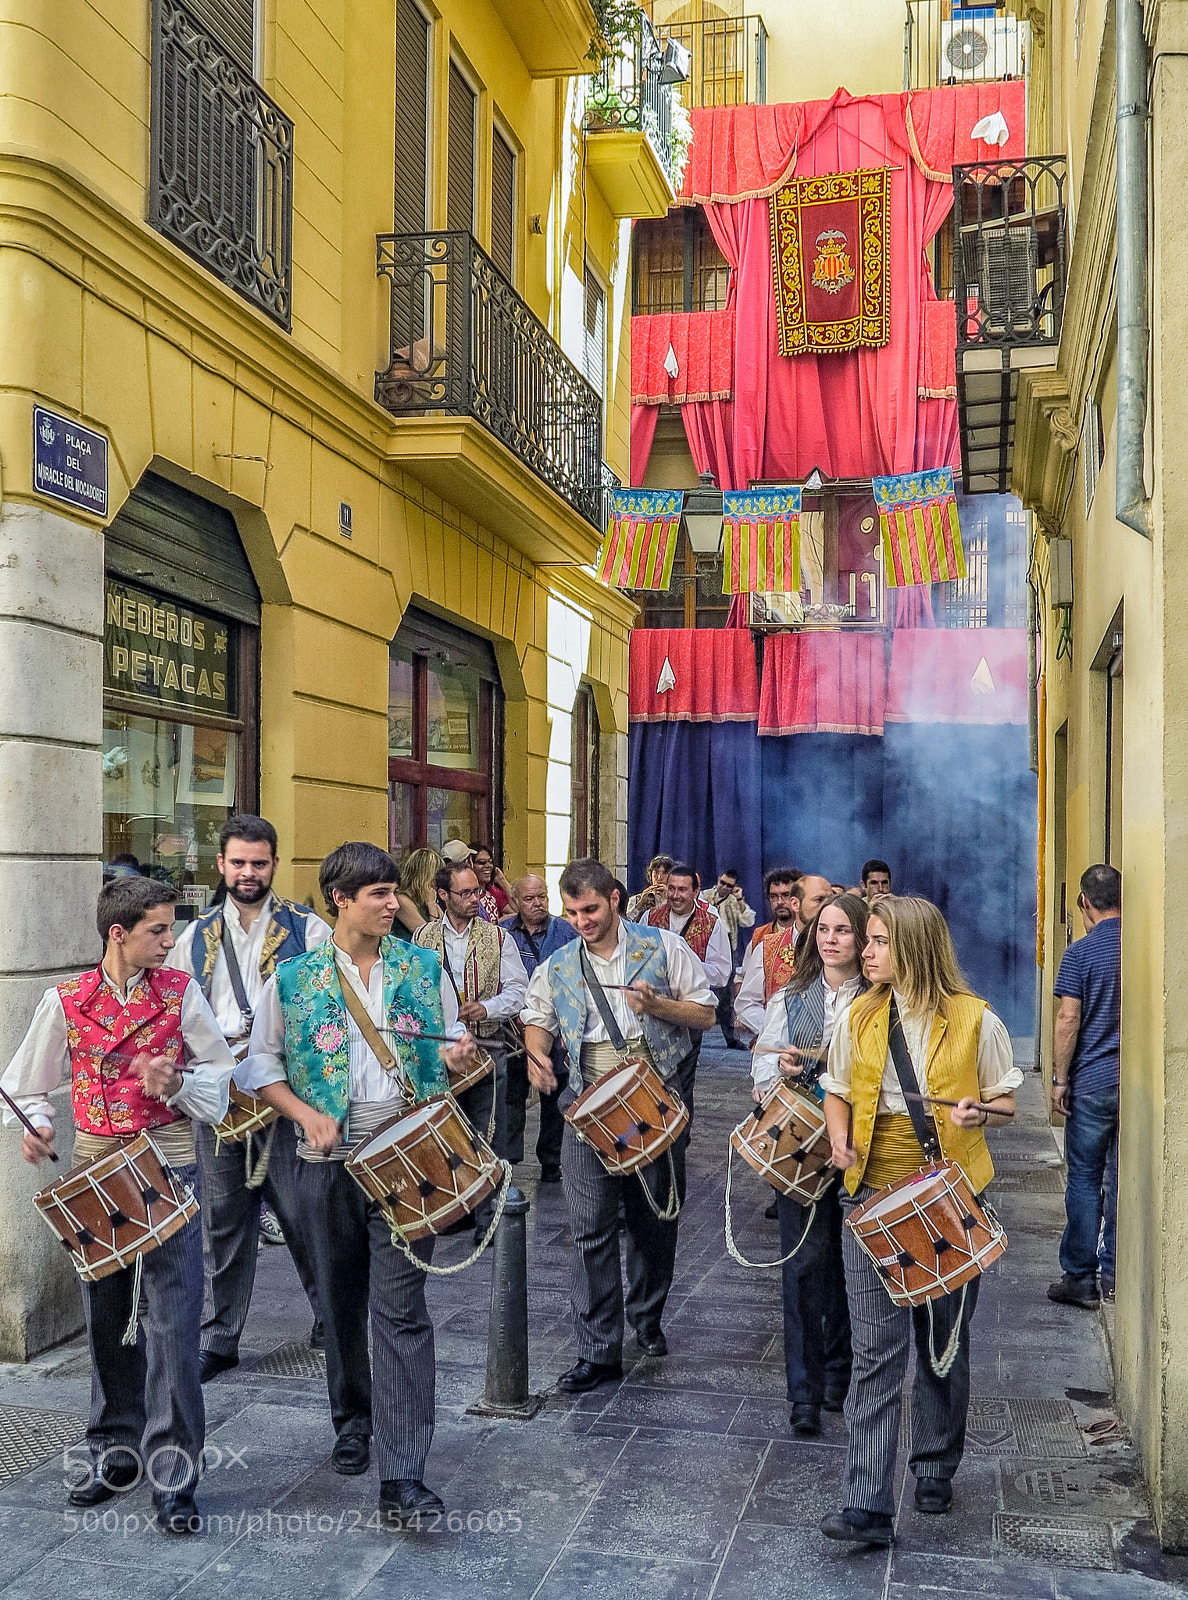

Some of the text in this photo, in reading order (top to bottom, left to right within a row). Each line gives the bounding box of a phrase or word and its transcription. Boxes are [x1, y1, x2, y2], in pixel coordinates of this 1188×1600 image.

[65, 433, 92, 456] PLAÇA
[66, 455, 82, 471] DEL
[38, 462, 105, 504] MIRACLE DEL MOCADORET
[107, 593, 205, 651] NEDEROS
[112, 645, 226, 701] PETACAS
